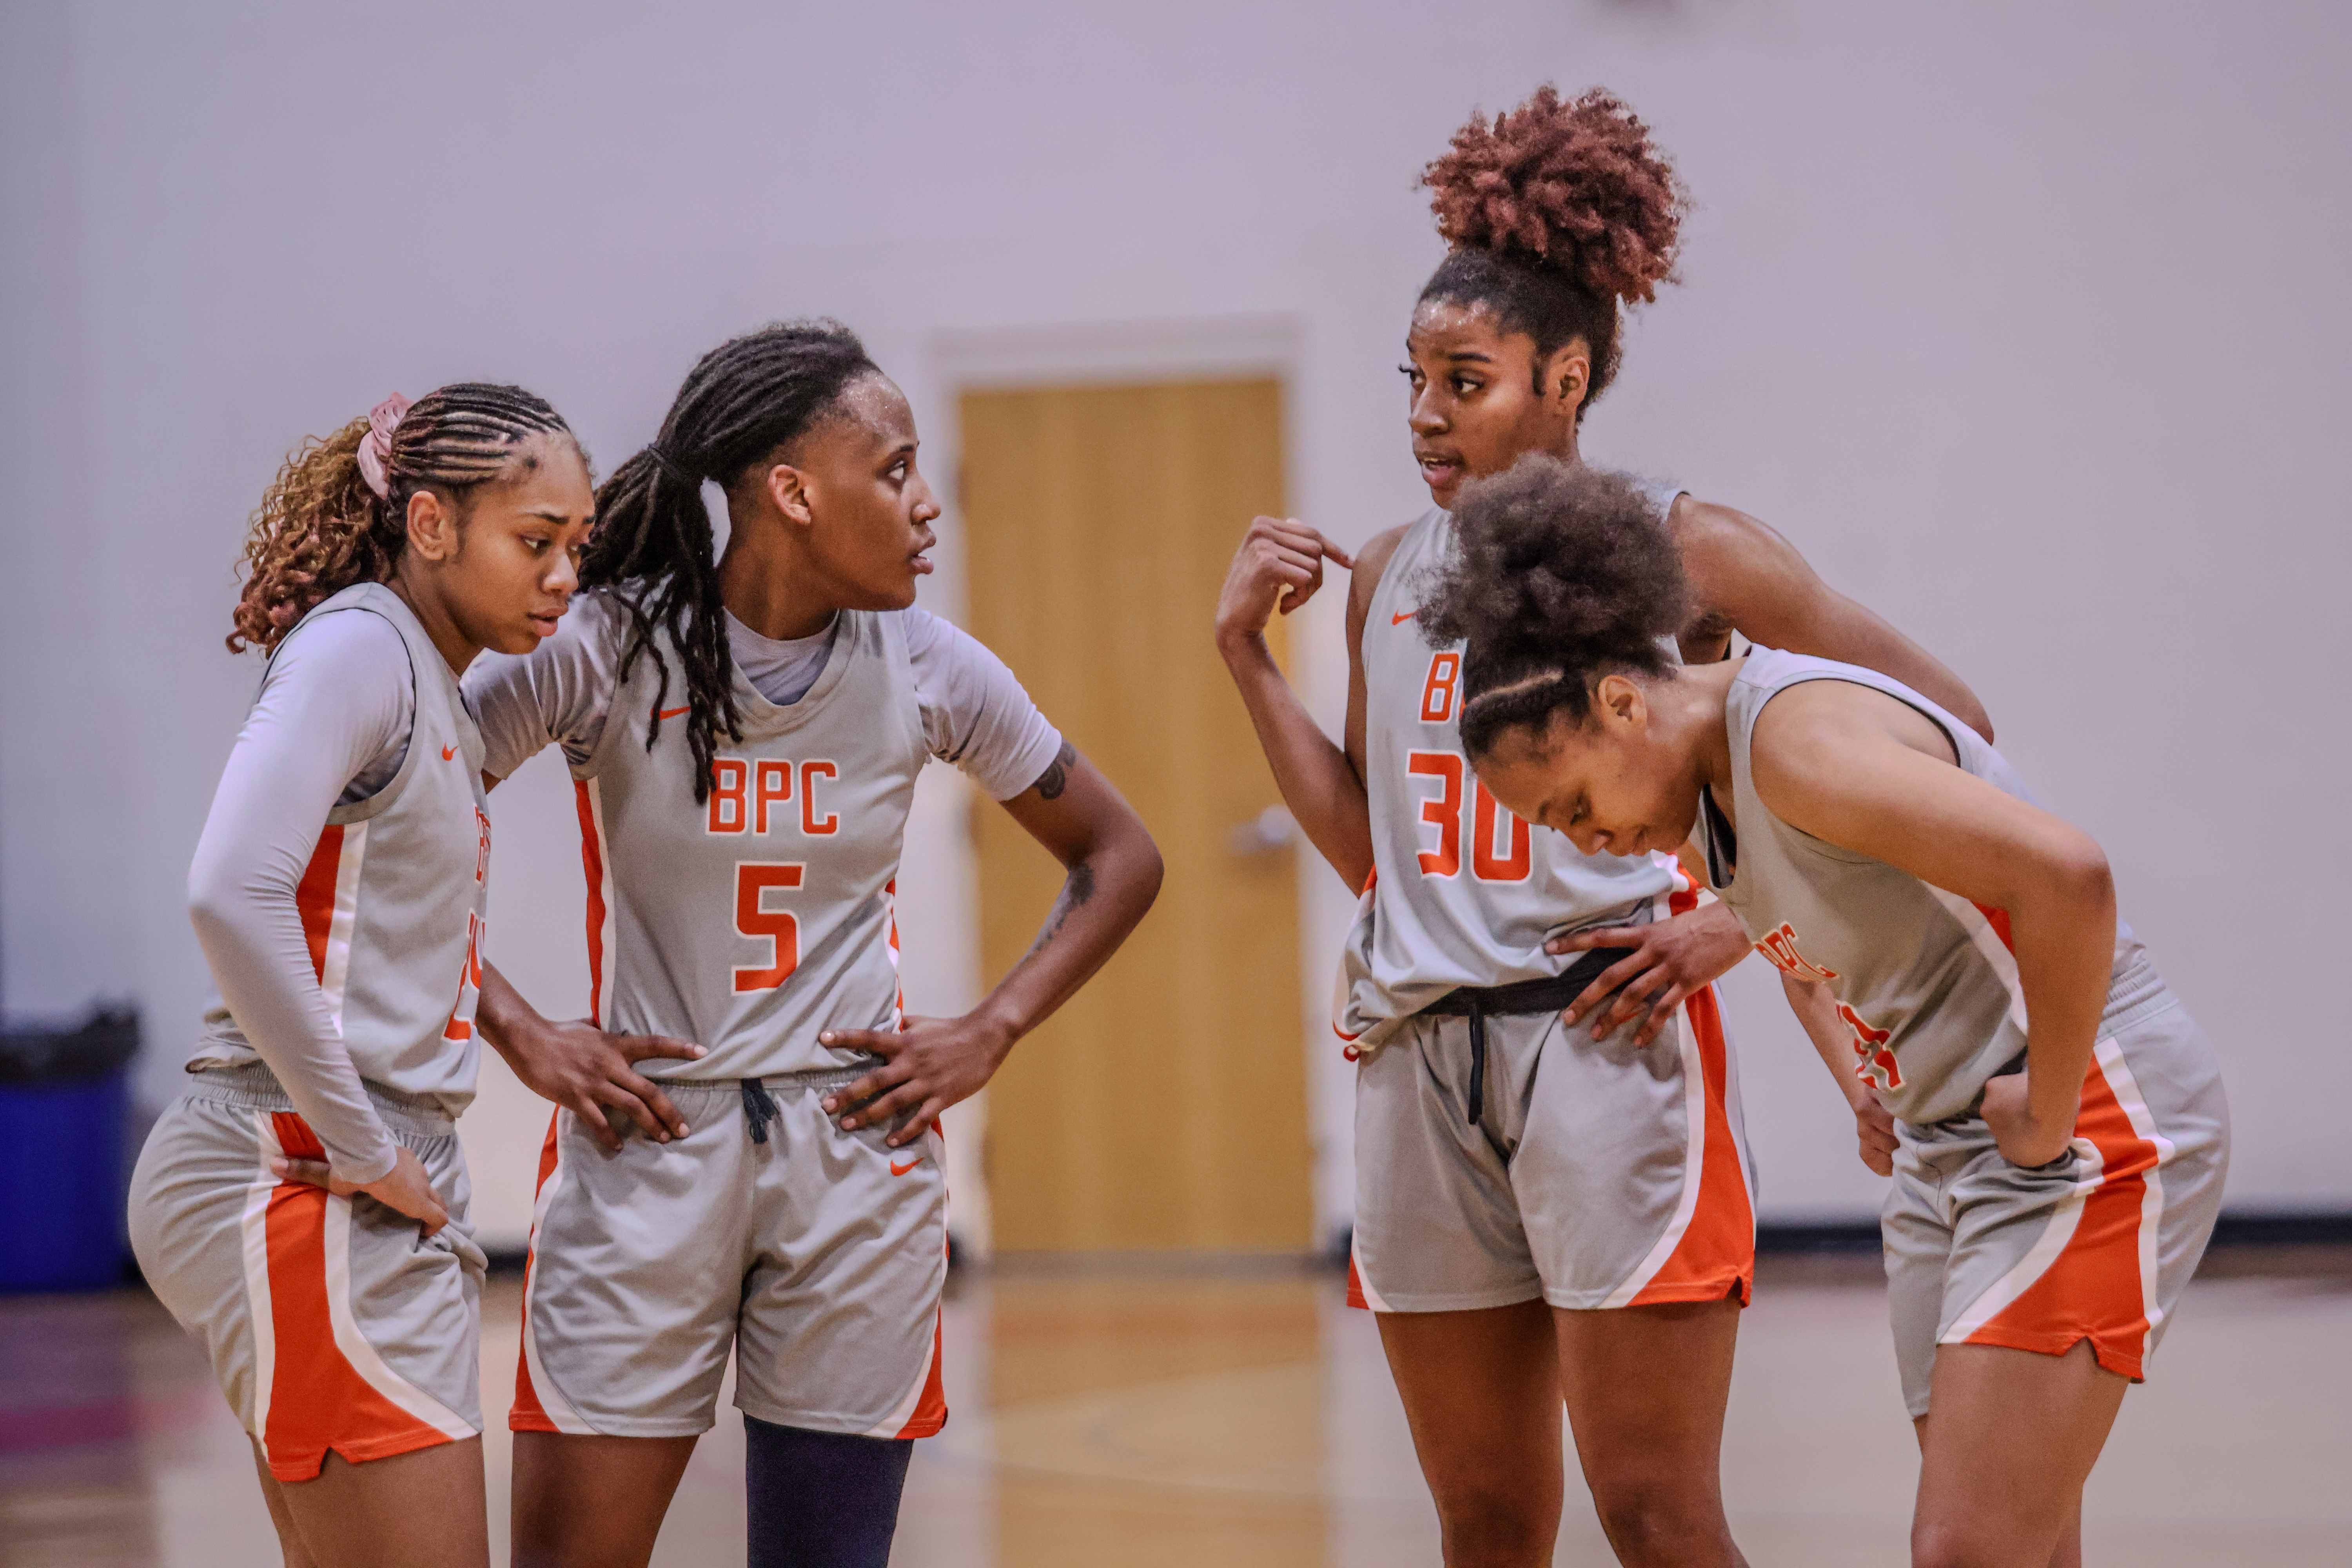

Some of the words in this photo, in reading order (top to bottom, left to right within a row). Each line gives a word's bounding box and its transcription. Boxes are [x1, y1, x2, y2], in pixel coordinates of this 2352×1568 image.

[706, 757, 840, 837] BPC
[1406, 749, 1533, 884] 30
[731, 861, 806, 996] 5
